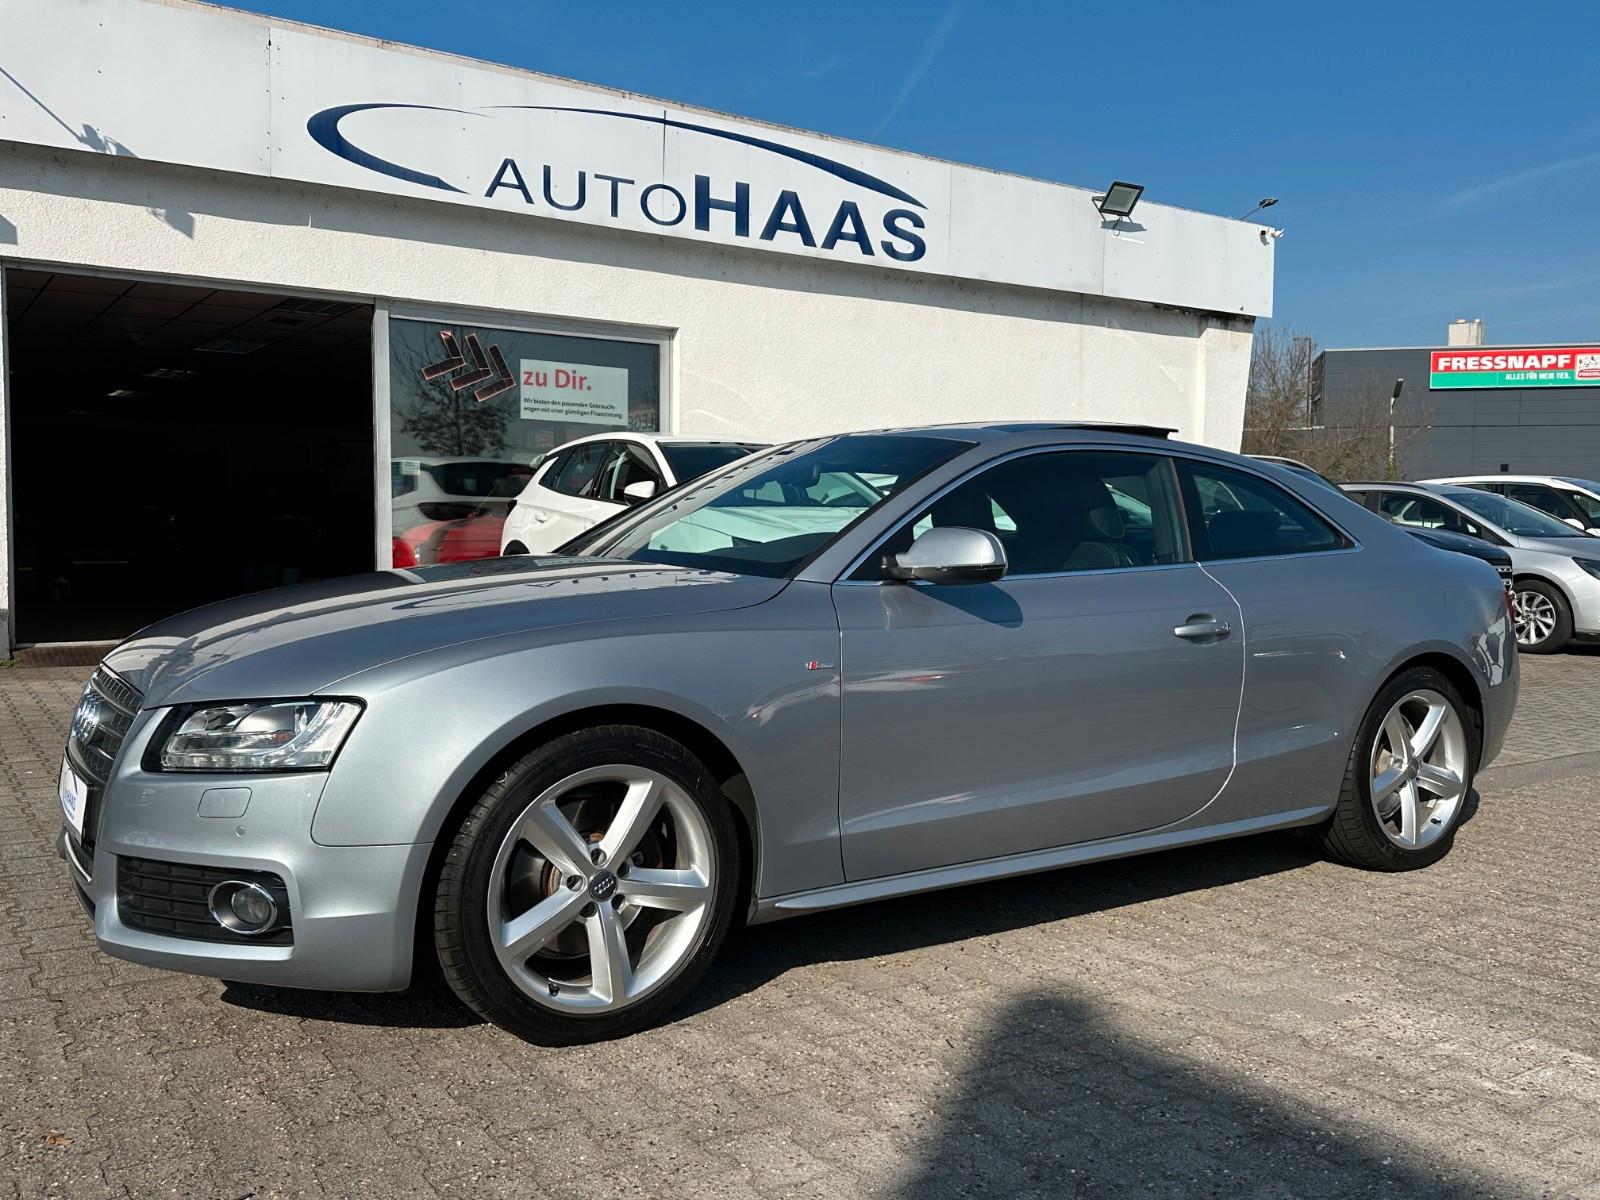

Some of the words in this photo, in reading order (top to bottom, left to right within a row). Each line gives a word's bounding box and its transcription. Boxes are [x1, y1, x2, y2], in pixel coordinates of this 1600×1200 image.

[1438, 355, 1571, 370] FRESSNAPF
[523, 370, 547, 387] zu
[555, 368, 592, 391] Dir.
[1526, 372, 1537, 380] FÜR
[1539, 372, 1555, 380] MEIN
